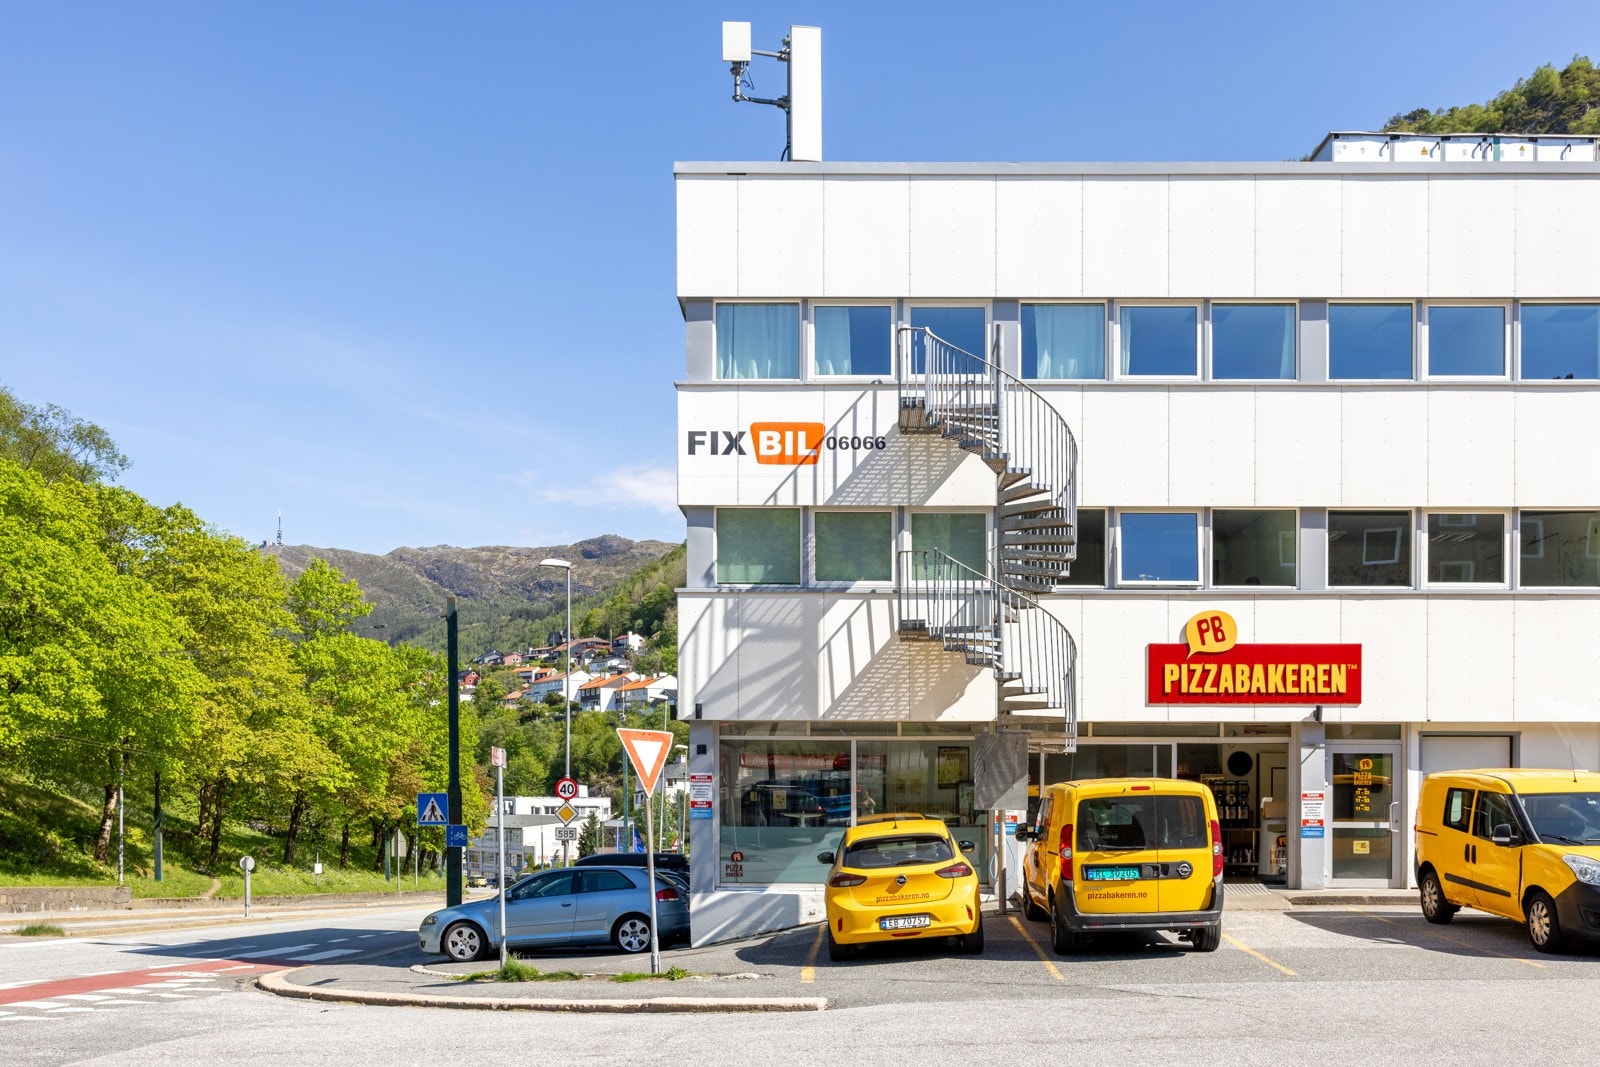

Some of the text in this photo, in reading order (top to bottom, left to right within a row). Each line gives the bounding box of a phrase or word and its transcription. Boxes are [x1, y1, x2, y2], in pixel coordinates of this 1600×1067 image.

[687, 431, 886, 456] FIX BIL 06066
[1196, 615, 1226, 646] PB
[1164, 664, 1347, 693] PIZZABAKEREN
[1362, 760, 1371, 768] PB
[1354, 772, 1372, 780] PIZZA
[560, 784, 574, 794] 40
[558, 830, 574, 838] 585
[1095, 869, 1137, 878] RL 30205
[876, 892, 930, 903] pizzabakeren.no
[1087, 891, 1148, 900] pizzabakeren.no
[888, 915, 927, 927] EB 70757
